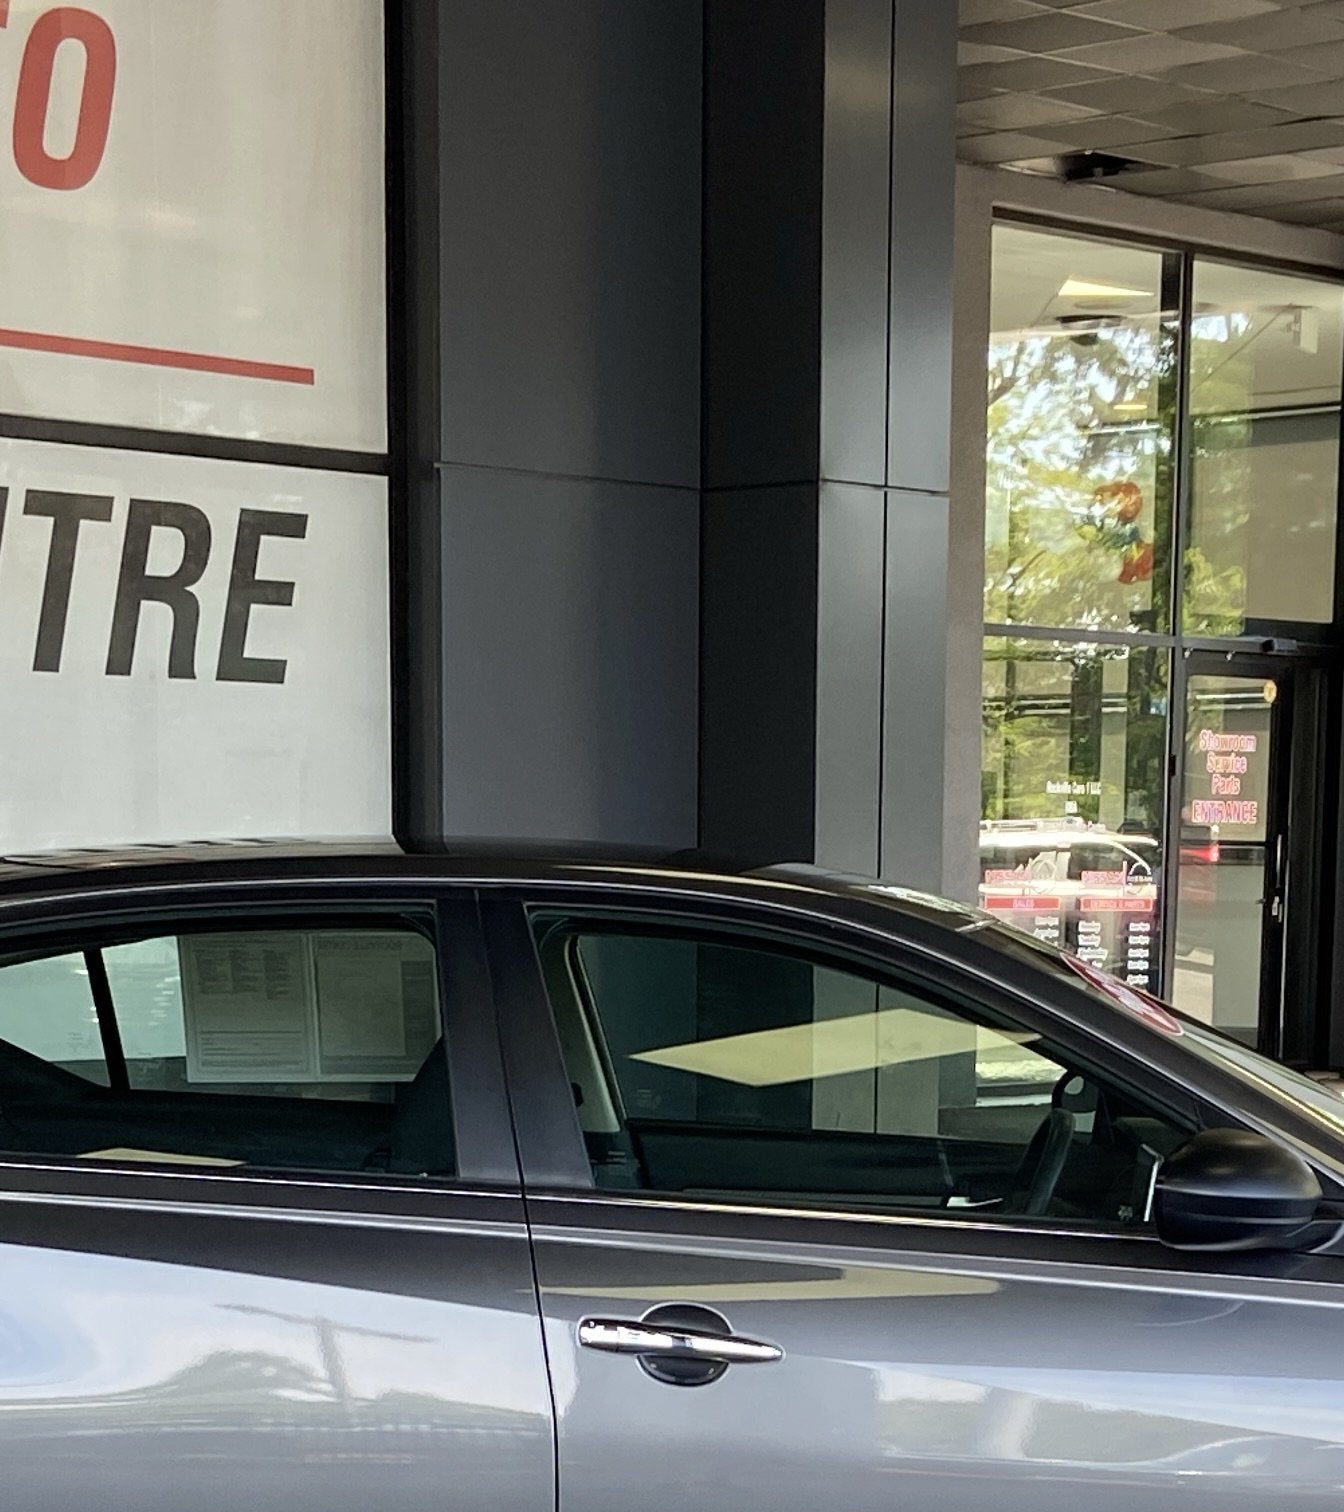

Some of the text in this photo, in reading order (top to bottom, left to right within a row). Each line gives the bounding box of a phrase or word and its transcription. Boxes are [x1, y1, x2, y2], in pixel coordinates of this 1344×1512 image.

[1199, 729, 1256, 752] Showroom
[1206, 751, 1247, 773] Service
[1211, 773, 1240, 795] Parts
[1191, 800, 1257, 824] ENTRANCE
